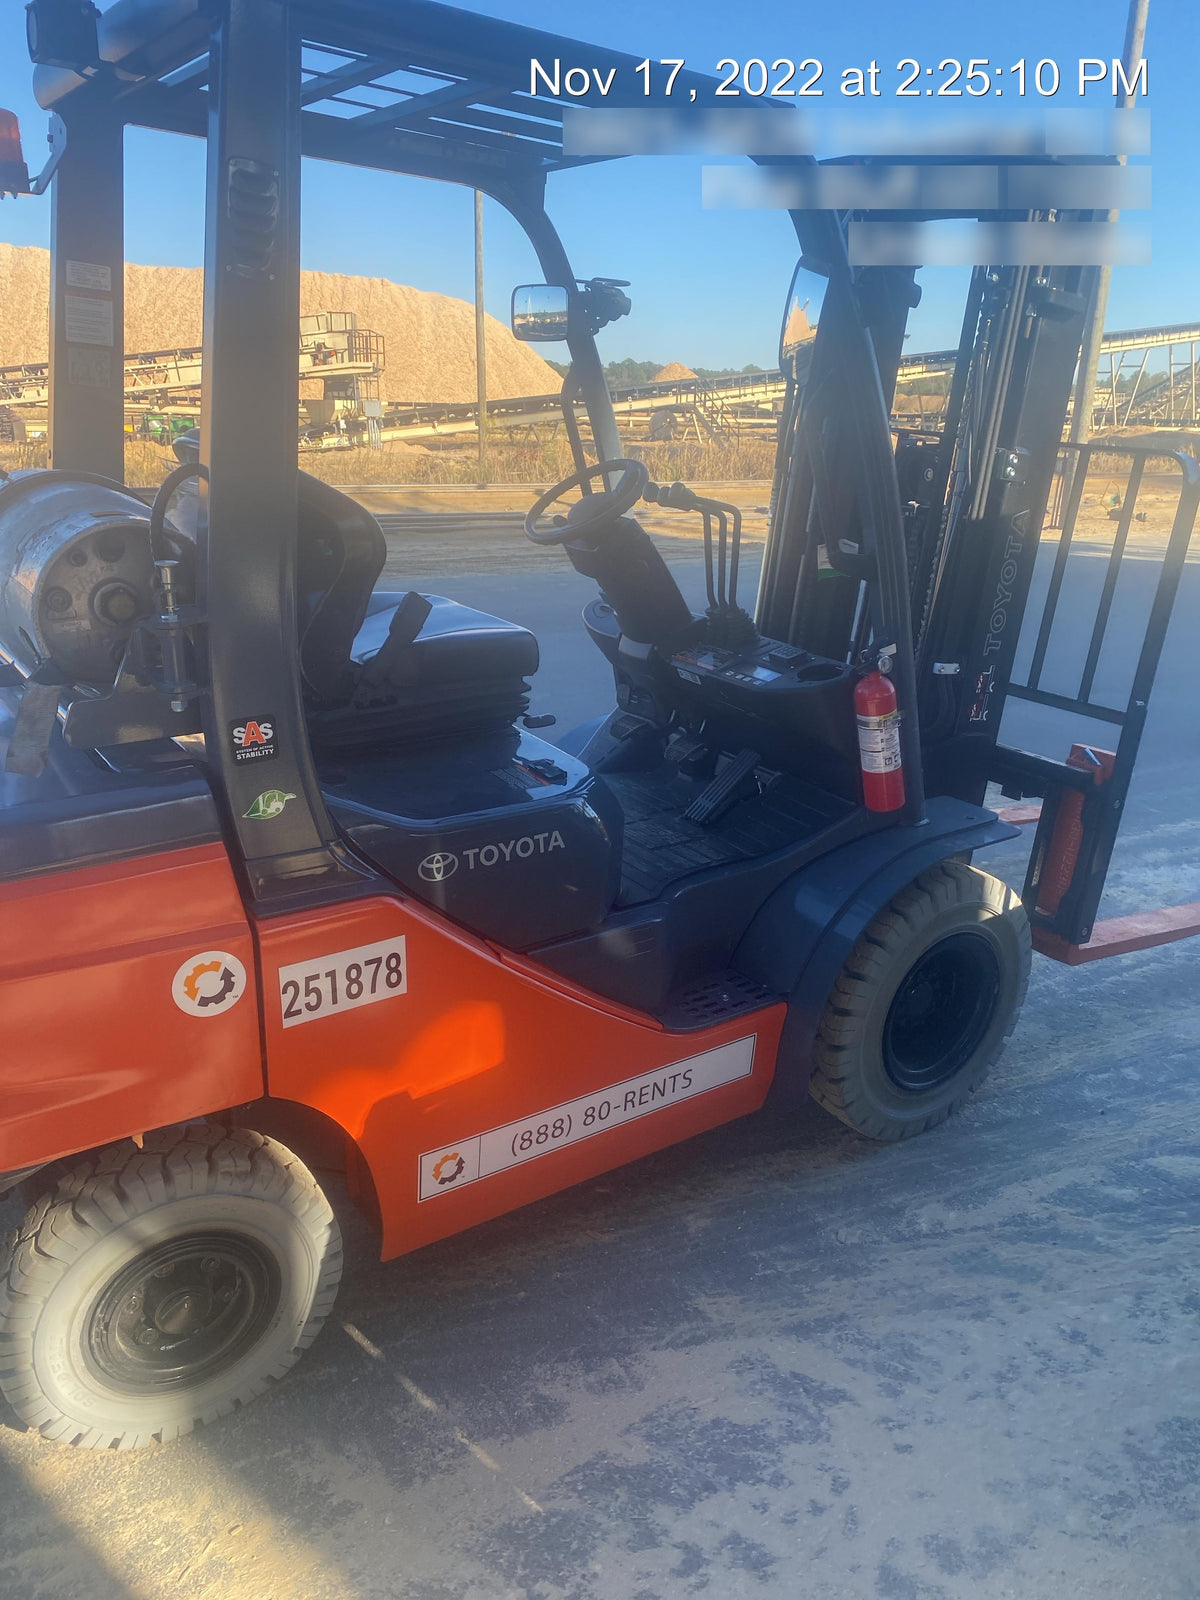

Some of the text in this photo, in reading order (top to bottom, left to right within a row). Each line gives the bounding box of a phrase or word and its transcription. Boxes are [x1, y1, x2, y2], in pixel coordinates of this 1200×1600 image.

[983, 508, 1032, 657] TOYOTA
[232, 721, 274, 747] SAS
[236, 748, 274, 760] STABILITY
[463, 830, 566, 870] TOYOTA
[281, 952, 402, 1020] 251878
[511, 1068, 693, 1157] (888) 80-RENTS
